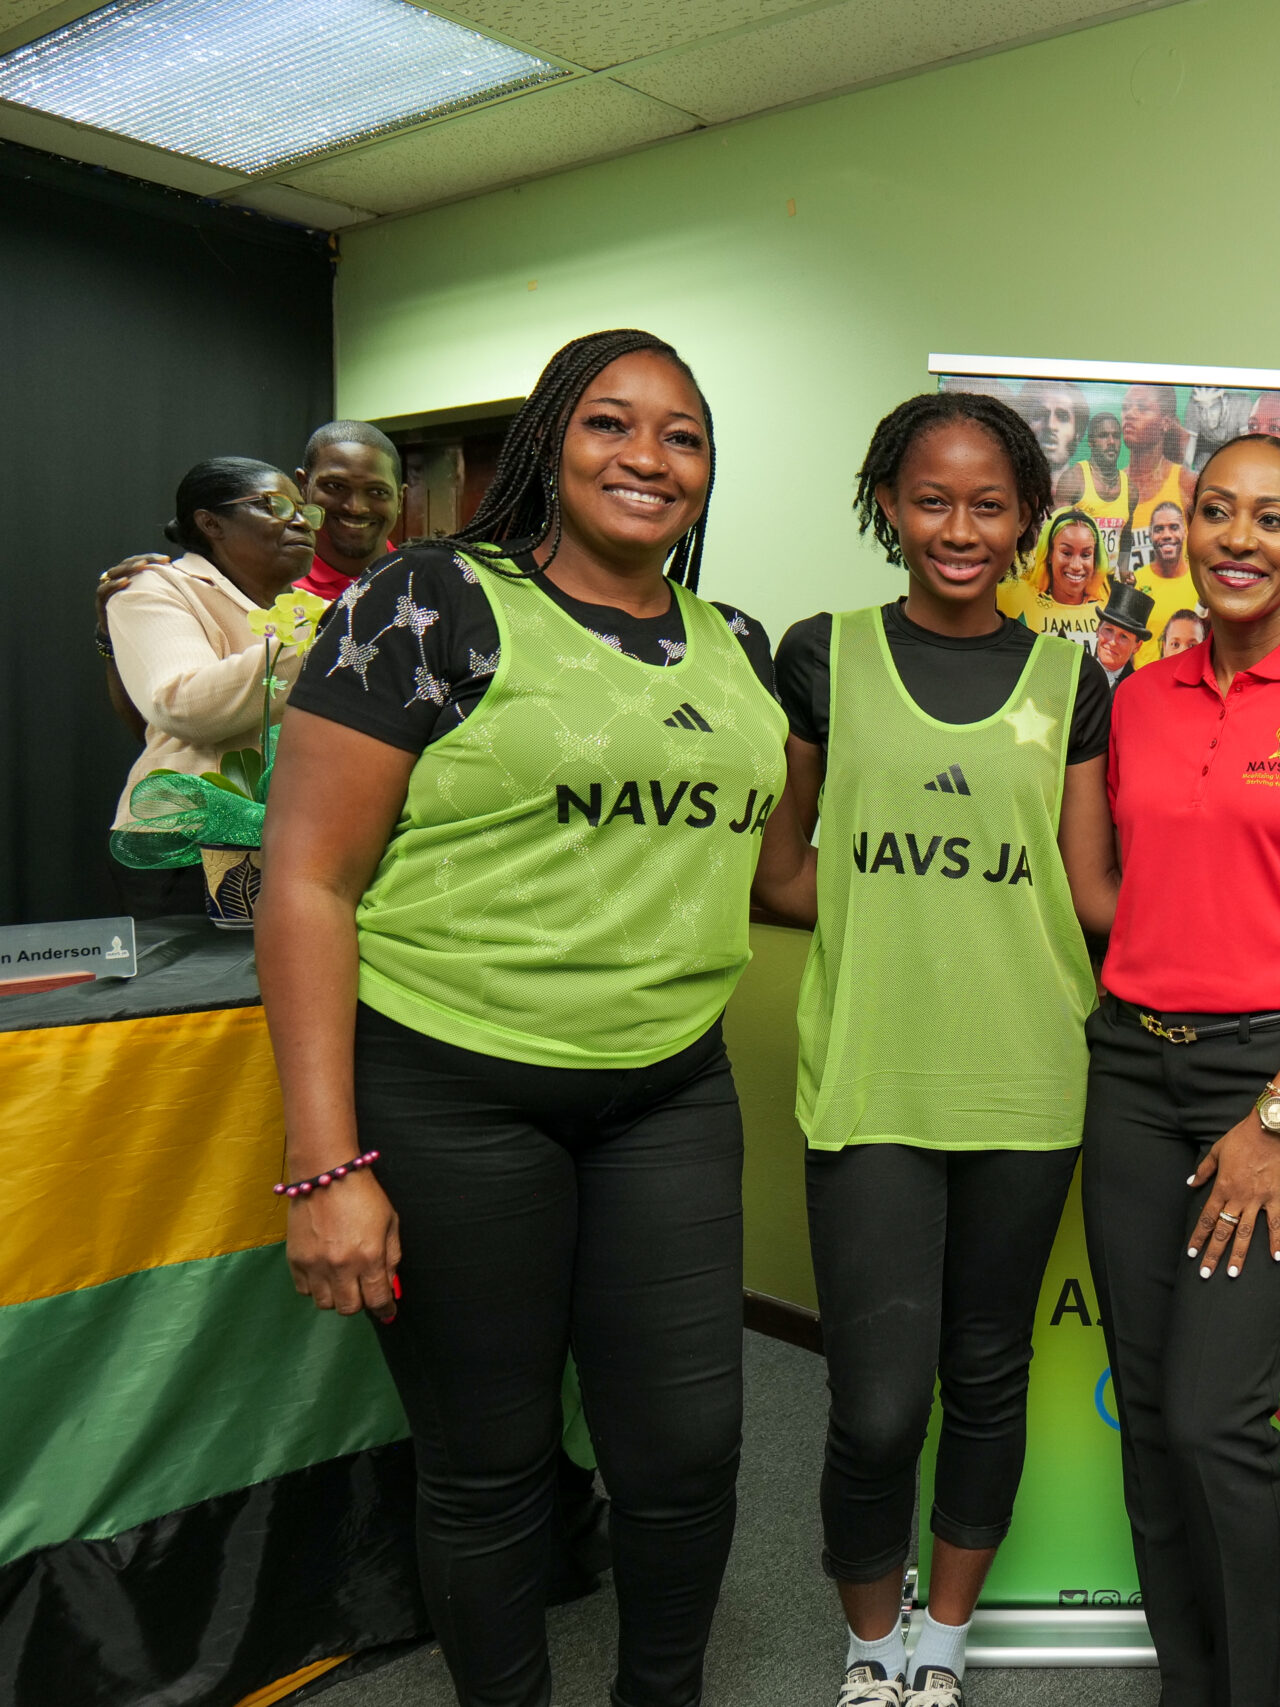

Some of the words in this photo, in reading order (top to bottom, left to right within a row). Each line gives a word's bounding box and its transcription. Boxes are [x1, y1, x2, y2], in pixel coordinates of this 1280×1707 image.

[1041, 616, 1097, 633] JAMAIC
[556, 780, 719, 829] NAVS
[852, 831, 971, 879] NAVS
[983, 843, 1034, 887] JA
[17, 945, 101, 962] Anderson
